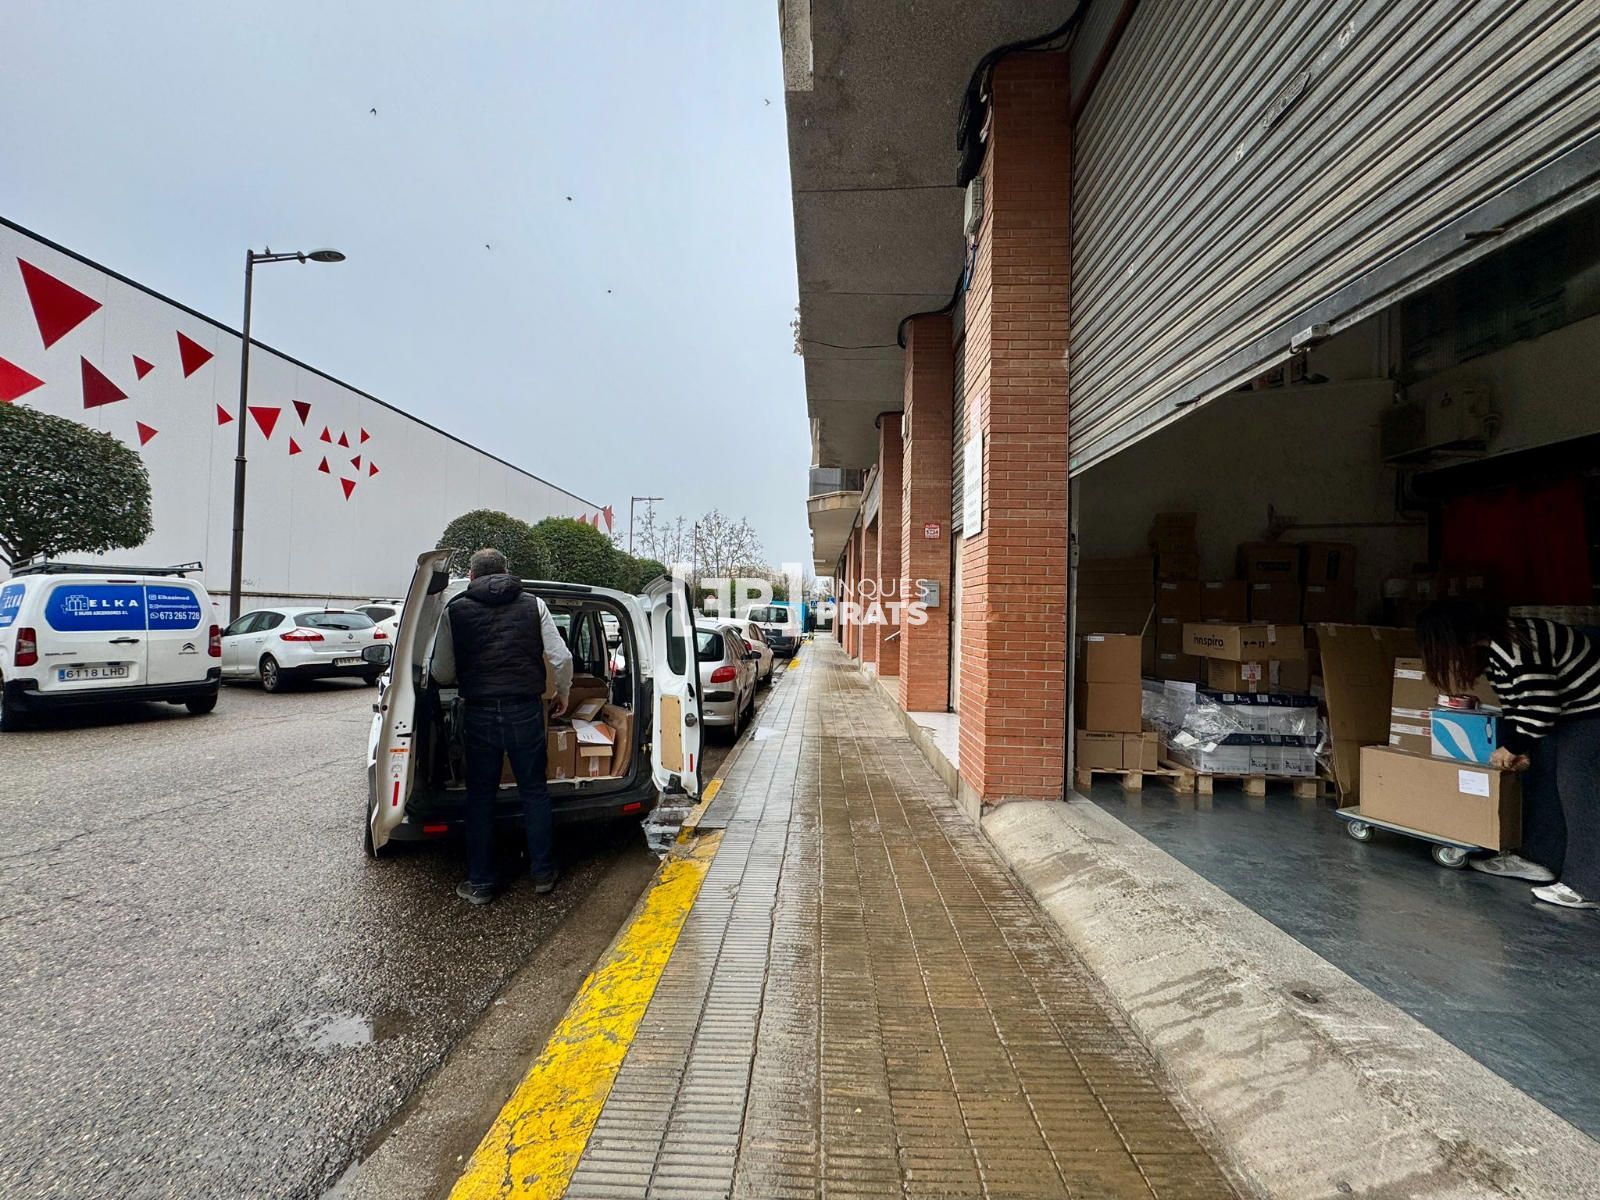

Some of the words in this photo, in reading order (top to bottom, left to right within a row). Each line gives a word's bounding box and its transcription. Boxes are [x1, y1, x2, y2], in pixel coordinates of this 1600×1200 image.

[89, 599, 139, 607] ELKA
[160, 611, 173, 620] 673
[174, 611, 187, 620] 265
[188, 611, 200, 620] 728
[66, 669, 98, 678] 6118
[102, 667, 125, 676] LHD
